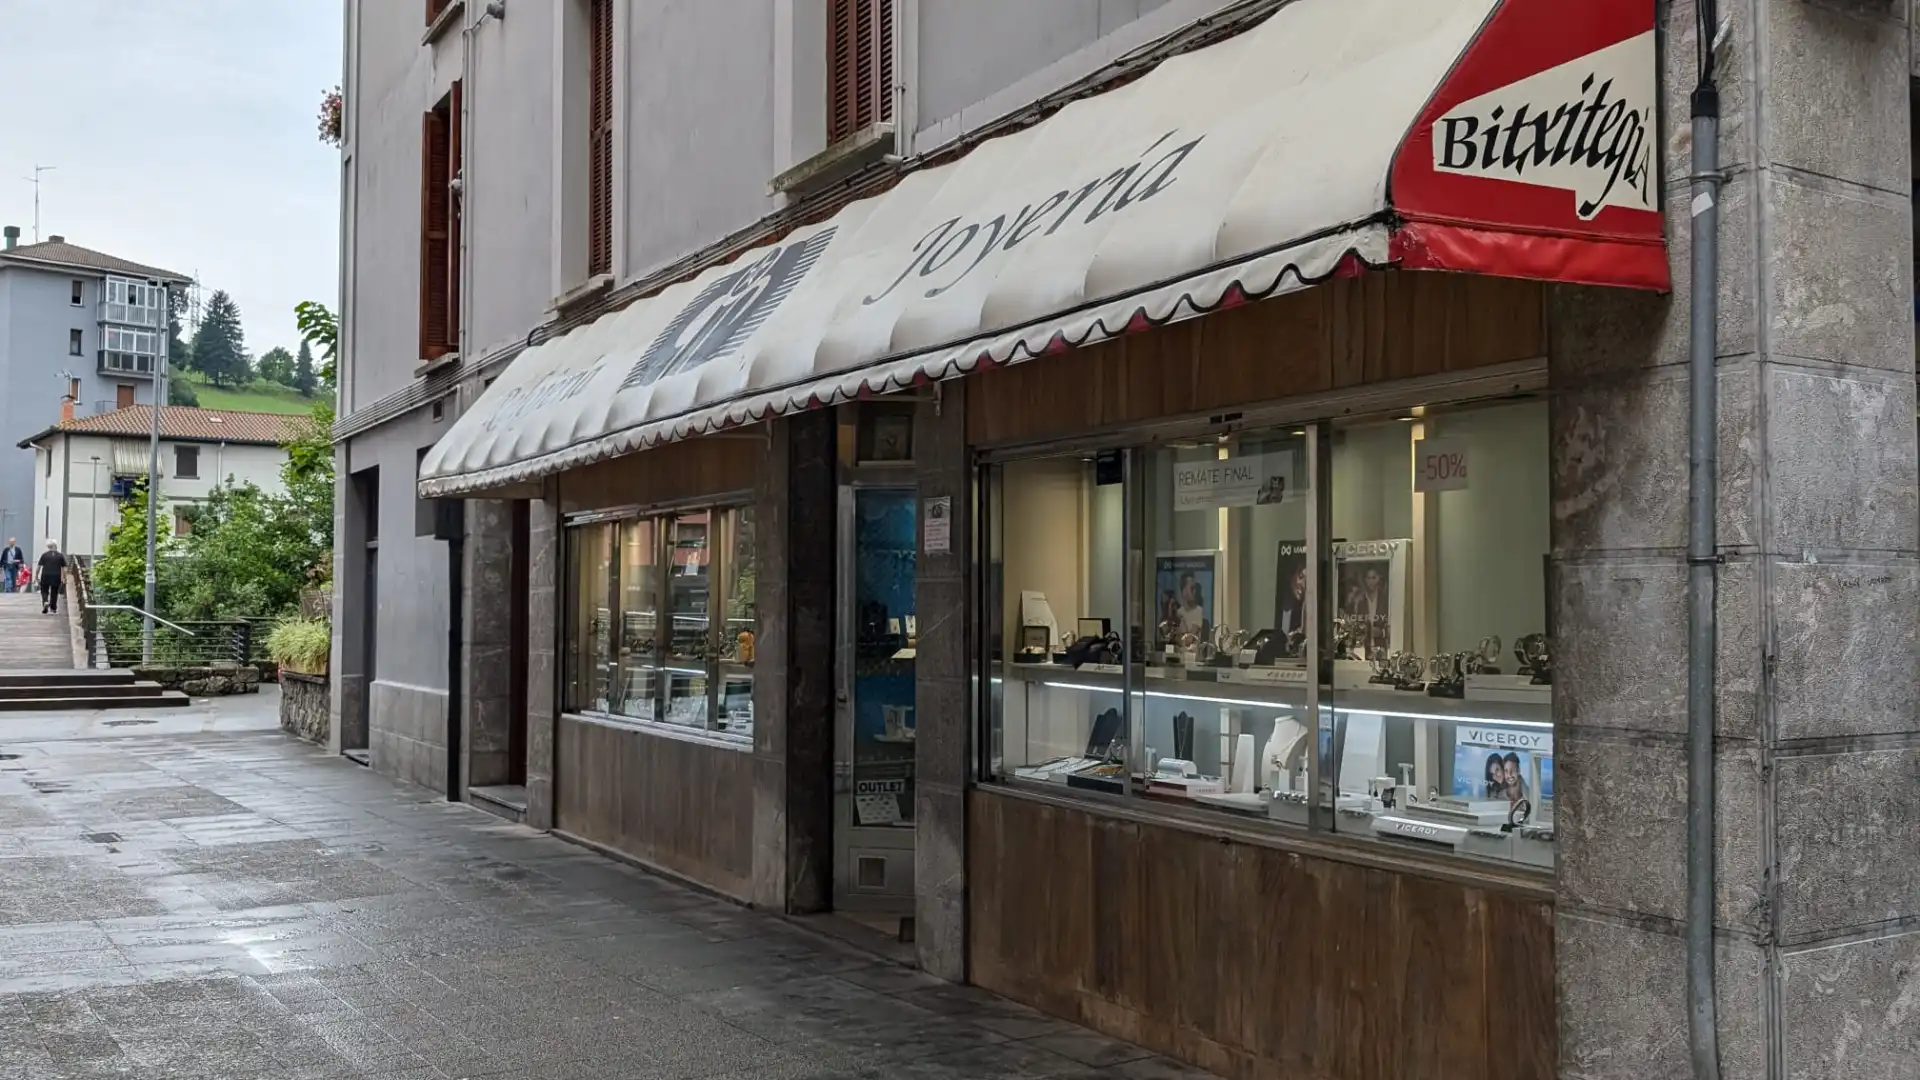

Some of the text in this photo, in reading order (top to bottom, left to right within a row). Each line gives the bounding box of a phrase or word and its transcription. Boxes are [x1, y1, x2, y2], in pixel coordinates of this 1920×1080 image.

[862, 128, 1207, 306] Joyería
[1178, 465, 1254, 488] REMATE FINAL
[1418, 453, 1467, 481] -50%
[1468, 730, 1541, 747] VICEROY
[858, 781, 903, 793] OUTLET
[1394, 822, 1439, 837] VICEROY
